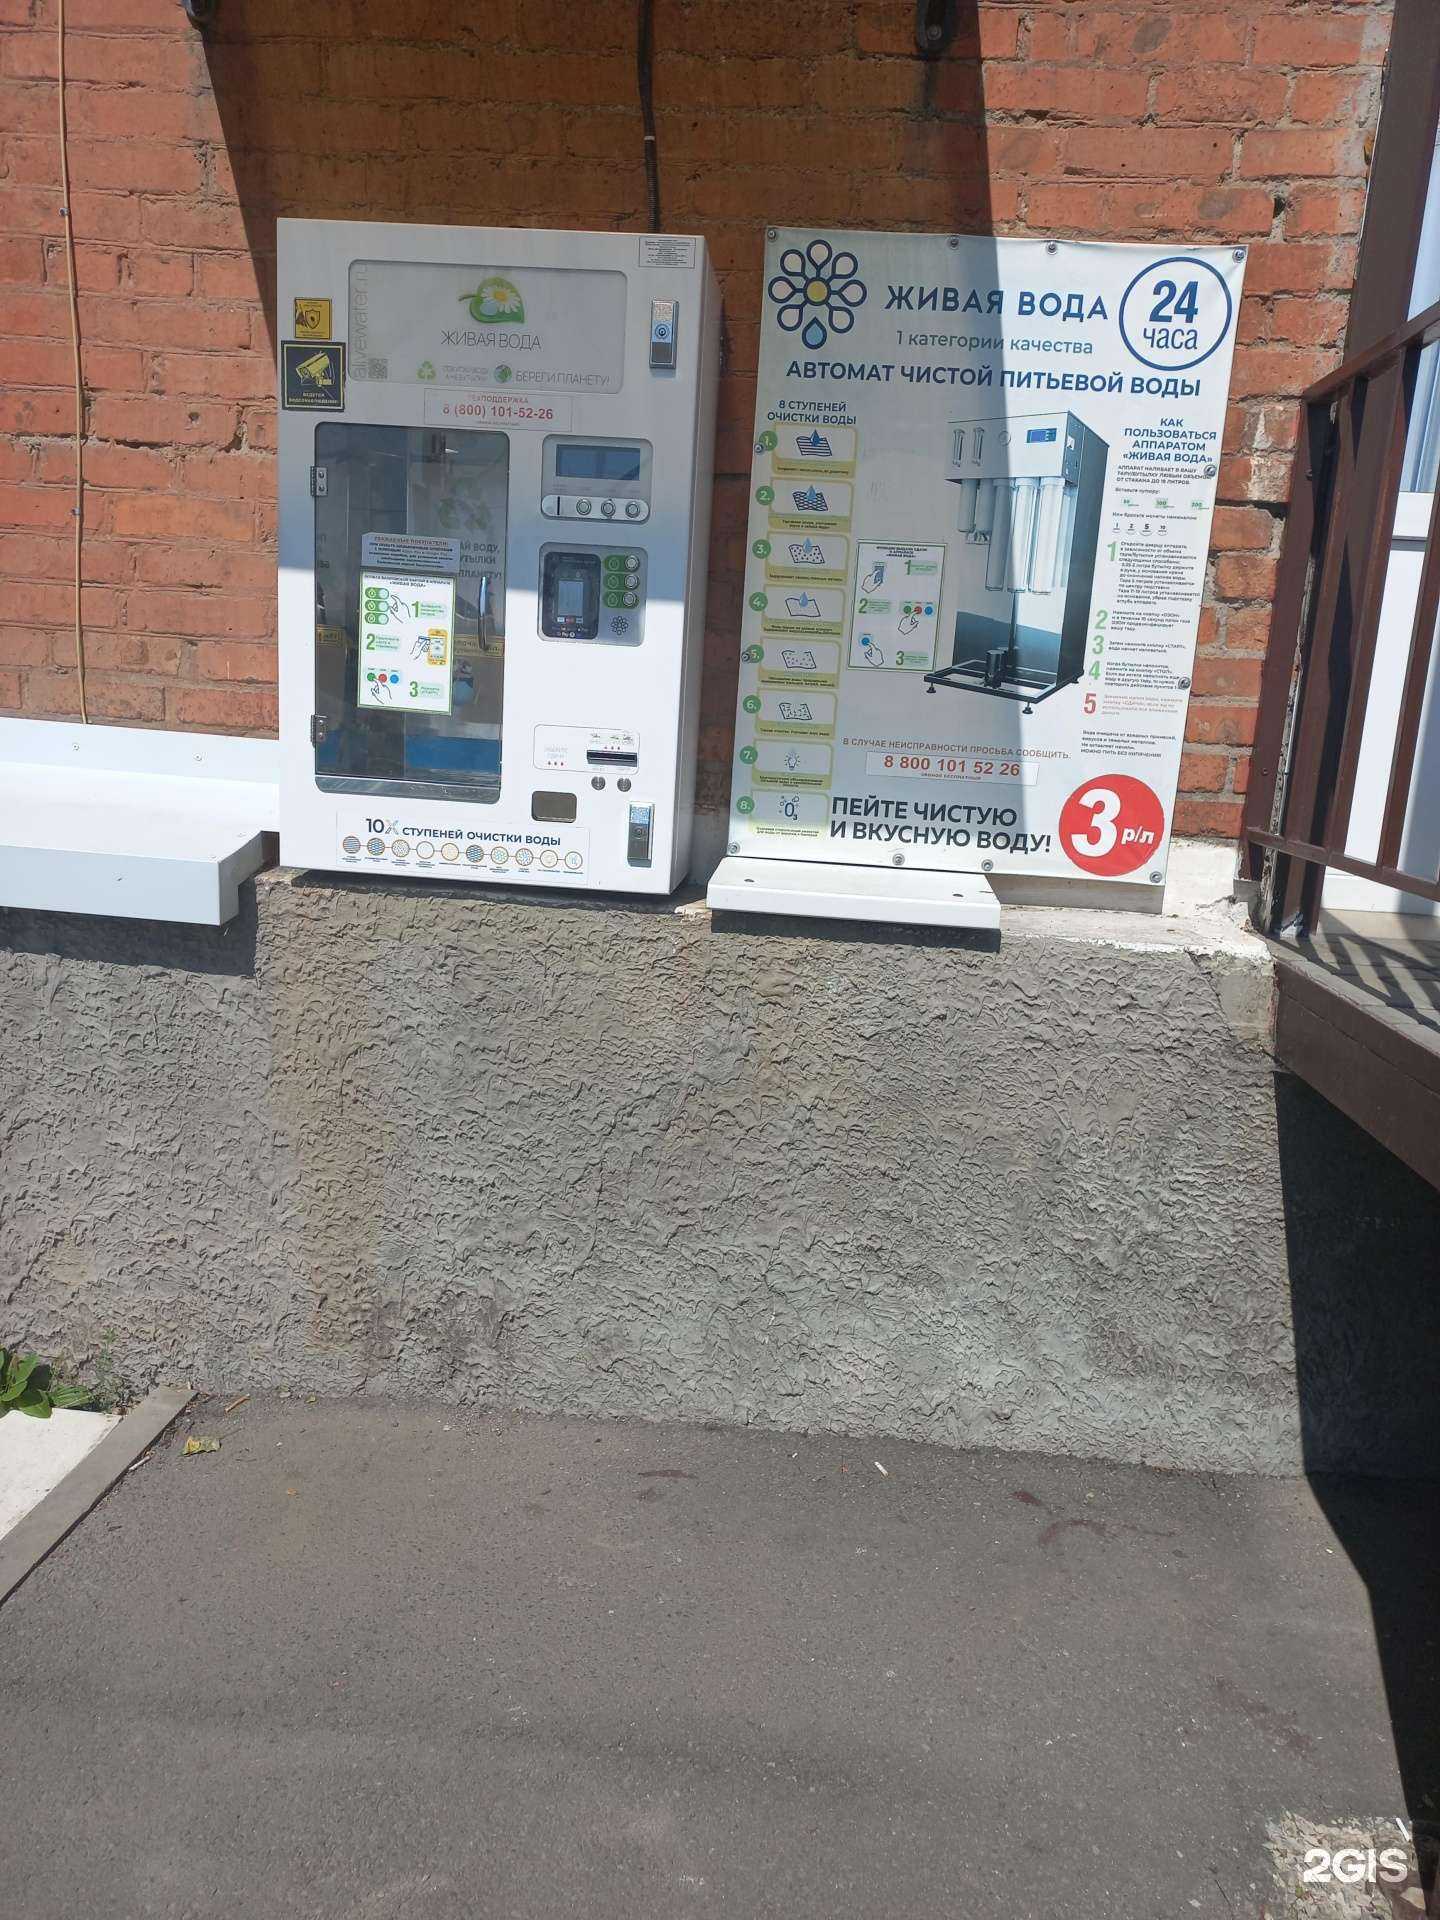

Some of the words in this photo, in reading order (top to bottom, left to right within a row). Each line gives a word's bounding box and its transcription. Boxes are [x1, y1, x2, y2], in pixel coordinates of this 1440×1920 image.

[885, 285, 1004, 316] ЖИВАЯ
[1017, 291, 1108, 322] ВОДА
[1149, 279, 1200, 324] 24
[441, 330, 496, 348] ЖИВАЯ
[498, 334, 543, 351] ВОДА
[897, 330, 903, 346] 1
[908, 333, 1005, 354] категории
[1010, 338, 1093, 355] качества
[1142, 327, 1199, 350] часа
[515, 371, 556, 384] БЕРЕГИ
[786, 360, 896, 382] АВТОМАТ
[901, 360, 994, 387] ЧИСТОЙ
[1000, 366, 1123, 395] ПИТЬЕВОЙ
[1130, 374, 1201, 398] ВОДЫ
[454, 404, 486, 418] (800)
[491, 406, 553, 420] 101-52-26
[779, 400, 785, 409] 8
[788, 400, 847, 412] СТУПЕНЕЙ
[767, 412, 820, 424] ОЧИСТКИ
[822, 415, 857, 425] ВОДЫ
[1160, 418, 1184, 427] КАК
[1124, 428, 1217, 440] ПОЛЬЗОВАТЬСЯ
[1132, 440, 1206, 451] АППАРАТОМ
[1123, 451, 1171, 461] «ЖИВАЯ
[1174, 454, 1213, 464] ВОДА»
[759, 490, 771, 501] 2.
[756, 544, 767, 555] 3.
[1107, 541, 1117, 561] 1
[460, 555, 496, 565] УТЫЛКИ
[904, 560, 912, 575] 1
[411, 601, 420, 618] 1
[858, 598, 868, 614] 2
[1095, 610, 1108, 630] 2
[366, 633, 376, 650] 2
[1092, 635, 1105, 655] 3
[896, 651, 905, 666] 3
[1089, 661, 1101, 681] 4
[409, 681, 418, 697] 3
[1083, 693, 1097, 714] 5
[851, 739, 887, 748] СЛУЧАЕ
[889, 741, 968, 753] НЕИСПРАВНОСТИ
[970, 745, 1014, 757] ПРОСЬБА
[884, 755, 894, 767] 8
[900, 756, 931, 770] 800
[937, 758, 966, 773] 101
[973, 761, 994, 774] 52
[999, 762, 1020, 777] 26
[832, 795, 908, 819] ПЕЙТЕ
[914, 802, 1018, 827] ЧИСТУЮ
[1071, 788, 1121, 857] 3
[1121, 825, 1155, 845] р/л
[402, 827, 463, 840] СТУПЕНЕЙ
[466, 831, 522, 843] ОЧИСТКИ
[525, 836, 561, 847] ВОДЫ
[831, 820, 846, 838] И
[853, 821, 971, 847] ВКУСНУЮ
[976, 830, 1051, 855] ВОДУ!
